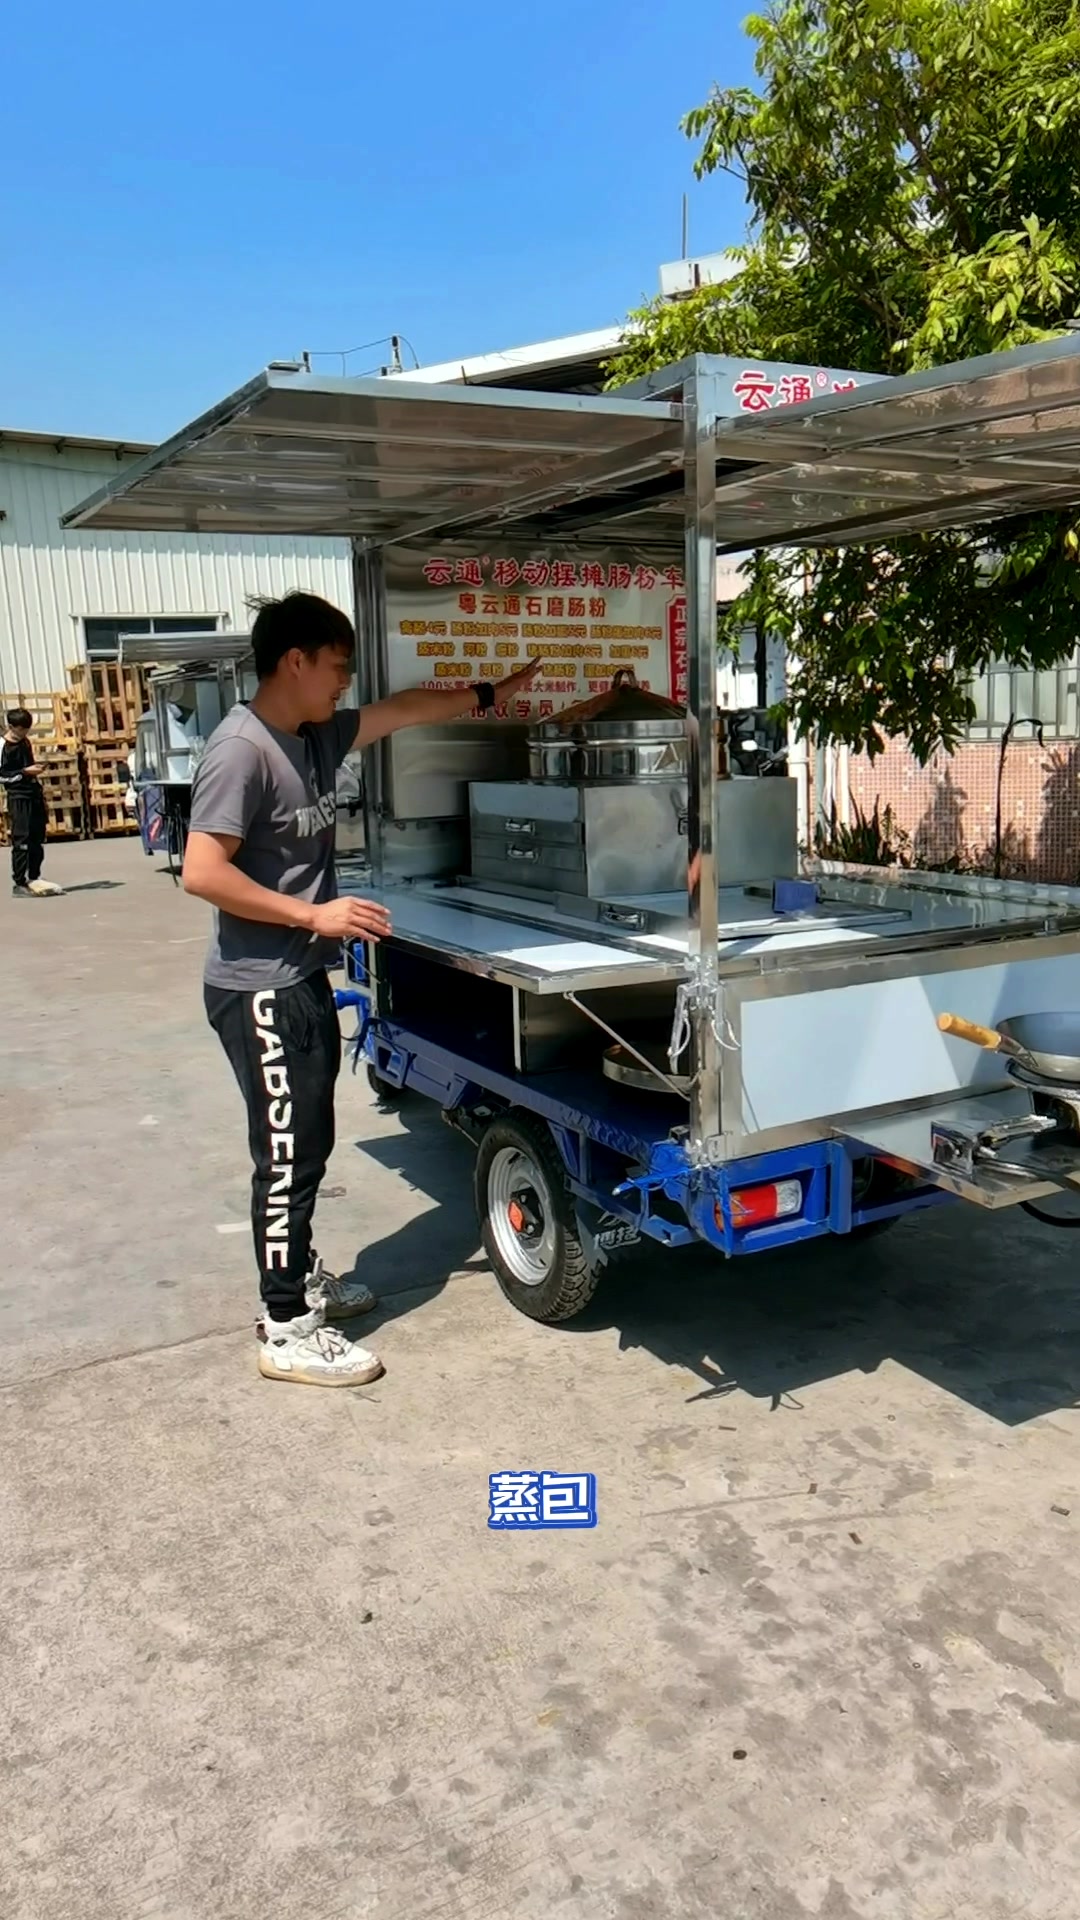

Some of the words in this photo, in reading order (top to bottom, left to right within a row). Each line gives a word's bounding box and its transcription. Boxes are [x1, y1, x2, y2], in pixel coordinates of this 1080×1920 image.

[458, 593, 606, 617] 粤云通石磨肠粉
